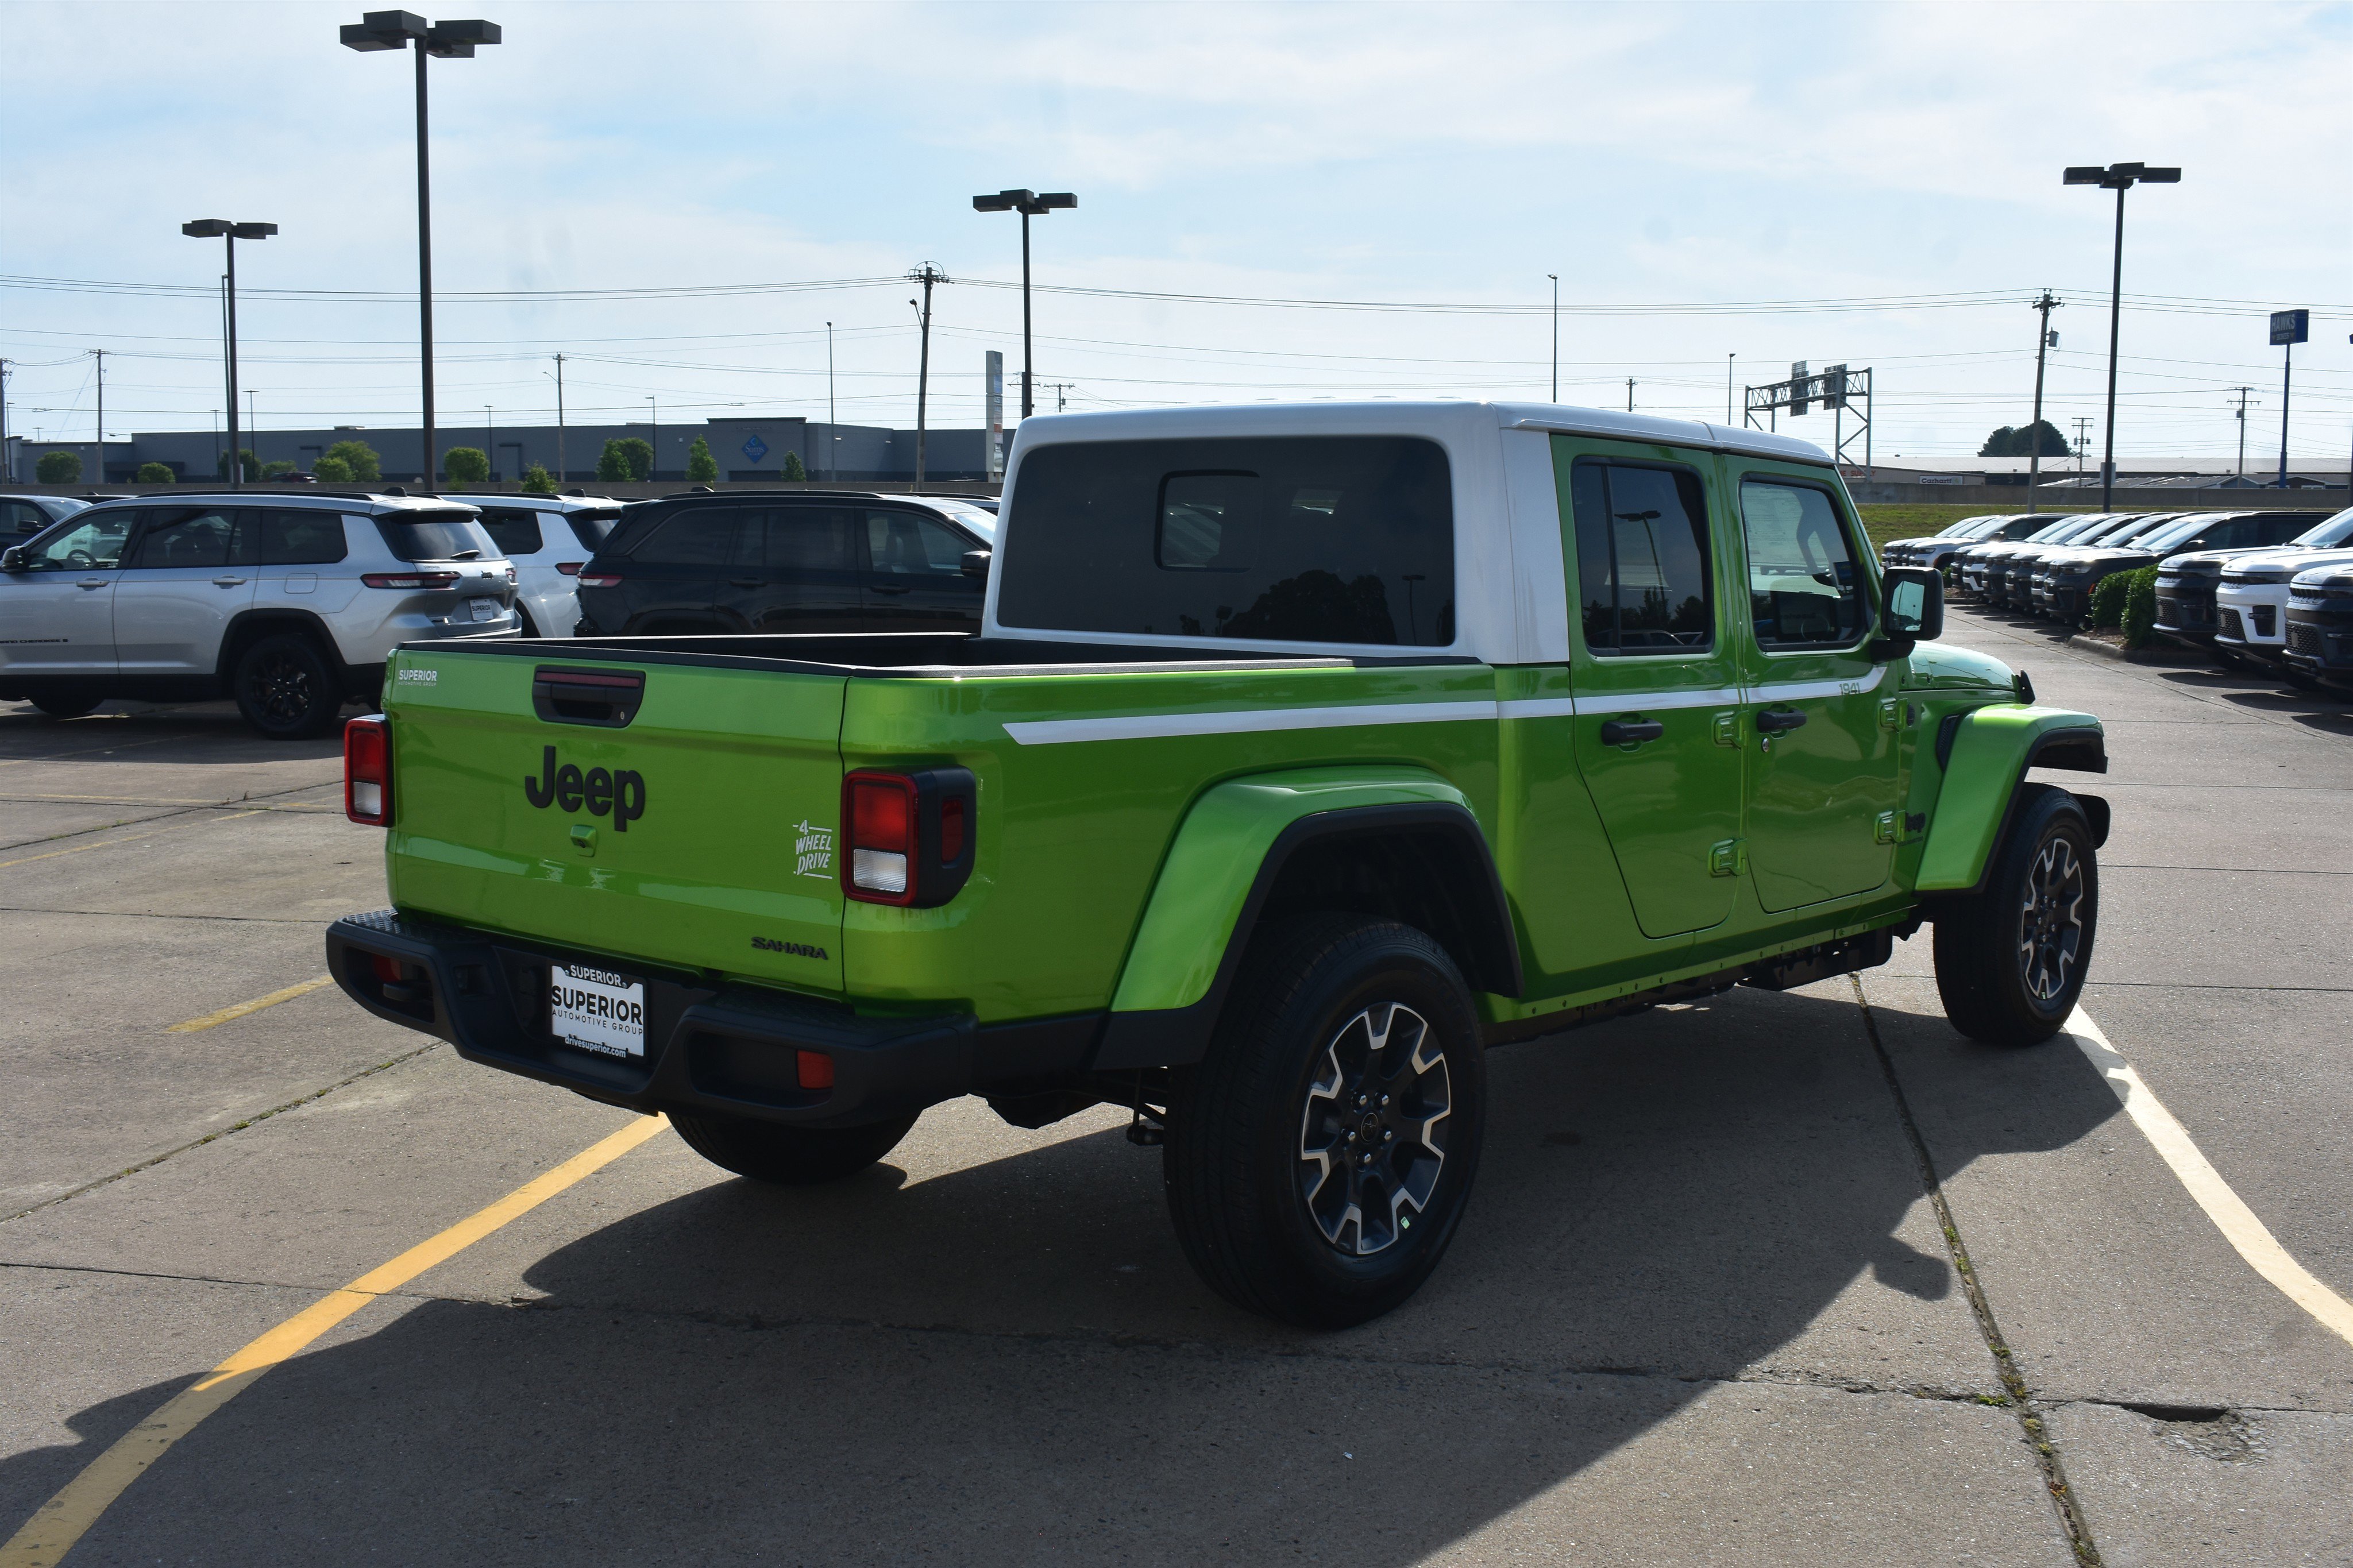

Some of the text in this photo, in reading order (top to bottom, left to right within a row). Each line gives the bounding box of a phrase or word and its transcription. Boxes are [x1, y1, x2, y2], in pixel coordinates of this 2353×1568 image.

[2271, 314, 2296, 333] HAWKS
[399, 669, 437, 681] SUPERIOR
[1839, 682, 1860, 696] 1941
[524, 745, 646, 832] Jeep
[799, 820, 808, 835] 4
[796, 835, 831, 855] WHEEL
[796, 852, 831, 875] DRIVE
[751, 936, 828, 960] SAHARA
[570, 965, 622, 986] SUPERIOR
[551, 985, 643, 1026] SUPERIOR
[551, 1009, 643, 1036] AUTOMOTIVE GROUP
[565, 1034, 626, 1058] drivesuperior.com
